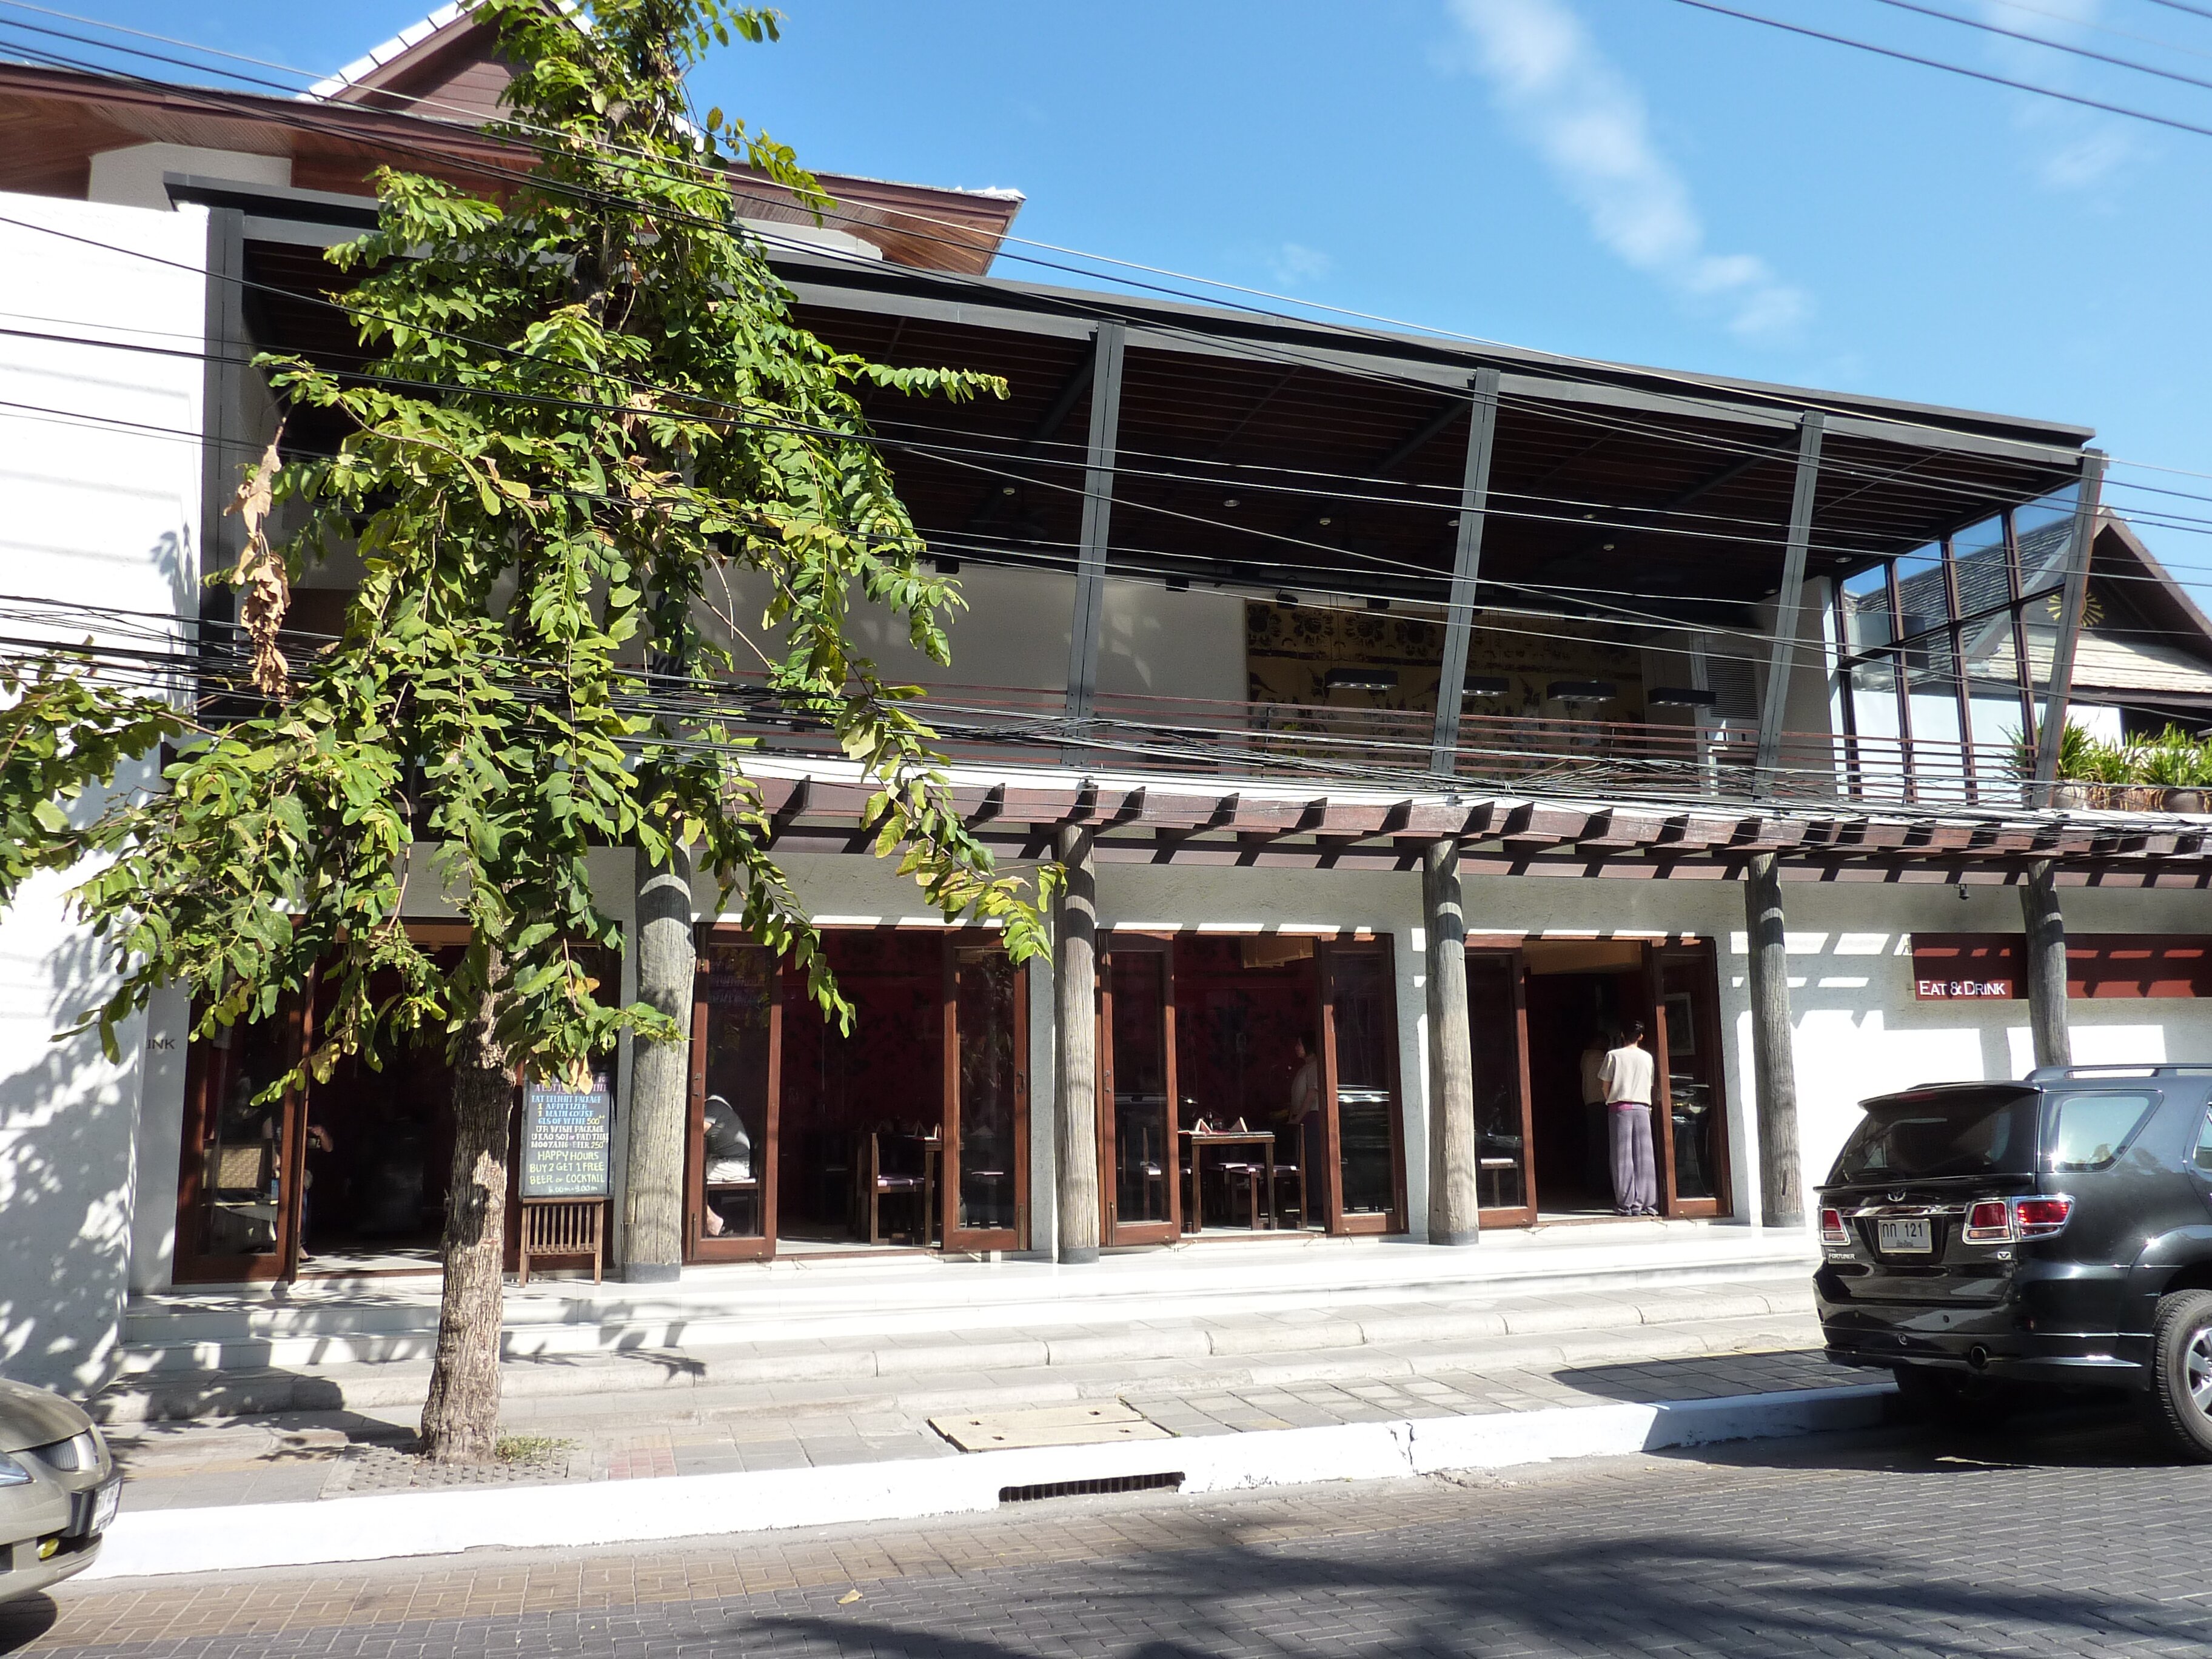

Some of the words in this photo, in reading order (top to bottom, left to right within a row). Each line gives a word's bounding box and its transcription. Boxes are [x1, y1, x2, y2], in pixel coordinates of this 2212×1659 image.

[1950, 981, 1962, 996] &
[147, 1039, 175, 1049] INK
[532, 1094, 545, 1103] EAT
[537, 1150, 569, 1161] HAPPY
[569, 1151, 599, 1161] HOURS
[529, 1163, 547, 1173] BUY
[548, 1163, 554, 1172] 2
[556, 1162, 574, 1171] GET
[576, 1163, 581, 1171] 1
[582, 1161, 605, 1171] FREE
[529, 1175, 553, 1185] BEER
[565, 1174, 605, 1183] COCKTAIL
[1905, 1222, 1923, 1237] 121
